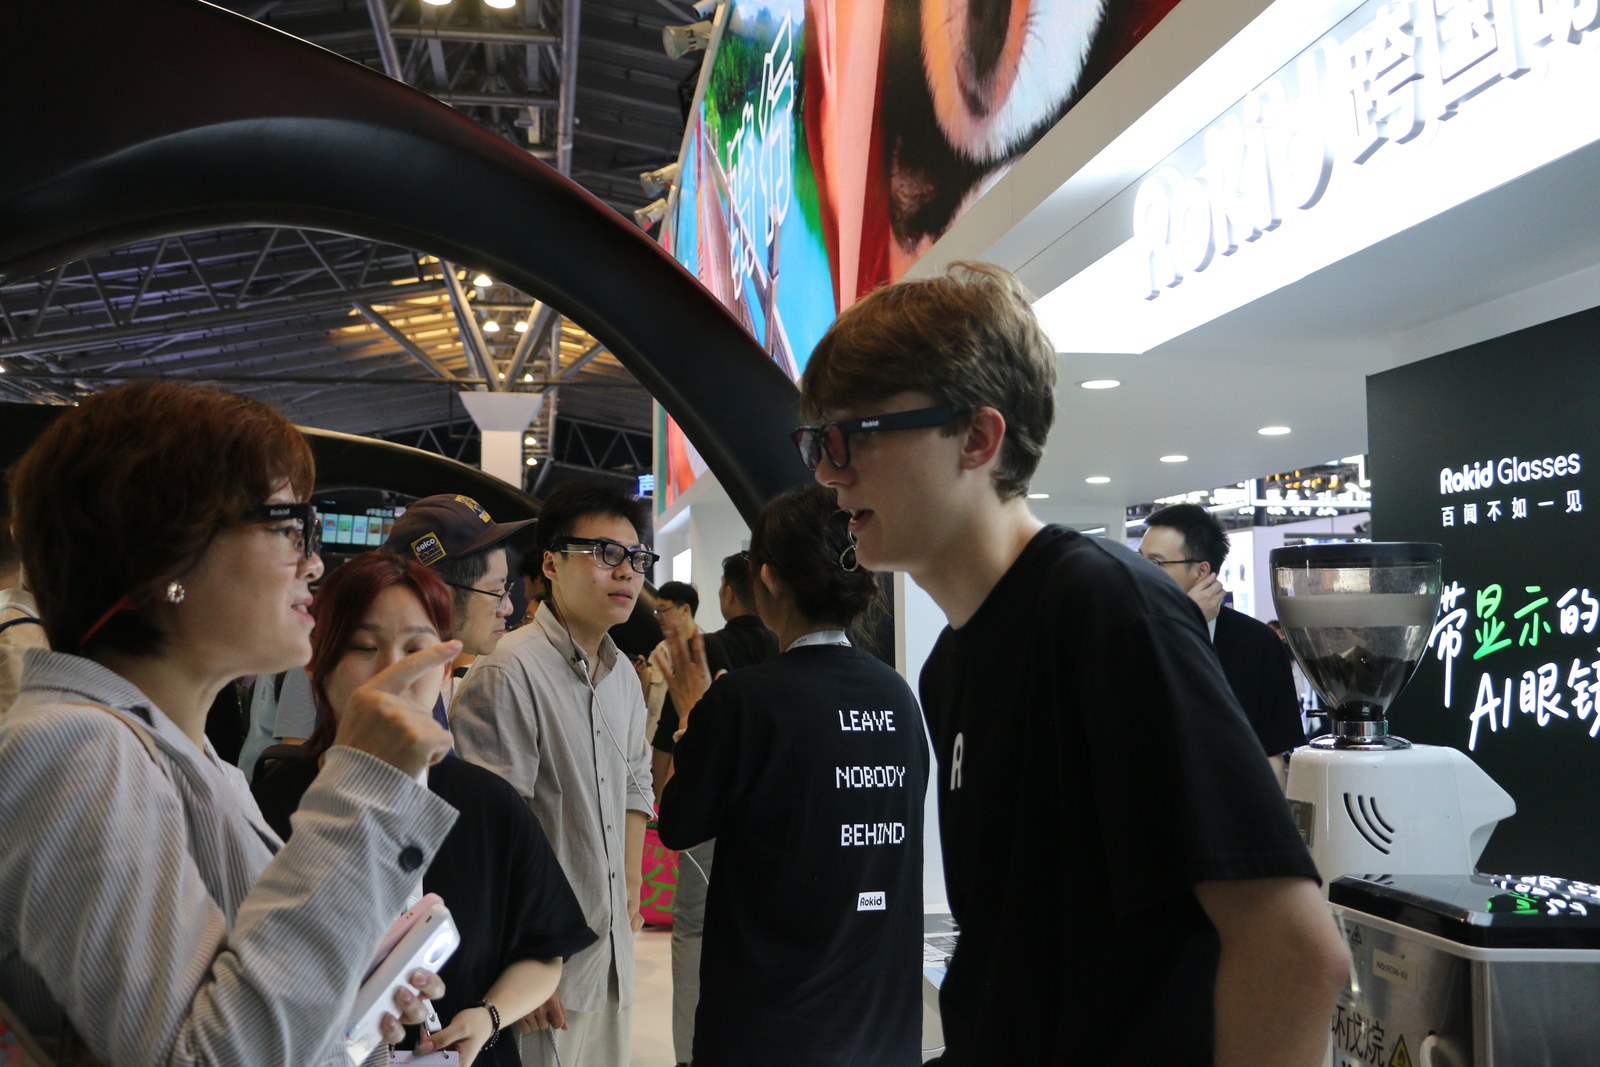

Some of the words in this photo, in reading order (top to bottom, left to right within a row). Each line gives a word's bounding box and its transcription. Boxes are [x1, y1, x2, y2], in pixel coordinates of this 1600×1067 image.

[861, 419, 880, 428] Rokid
[1440, 460, 1493, 494] Rokid
[1497, 453, 1580, 485] Glasses
[1441, 490, 1582, 527] 百闻不如一见
[1429, 581, 1600, 708] 带显示的
[838, 710, 896, 731] LEAVE
[836, 766, 905, 788] NOBODY
[841, 823, 905, 846] BEHIND
[859, 896, 883, 906] Rokid
